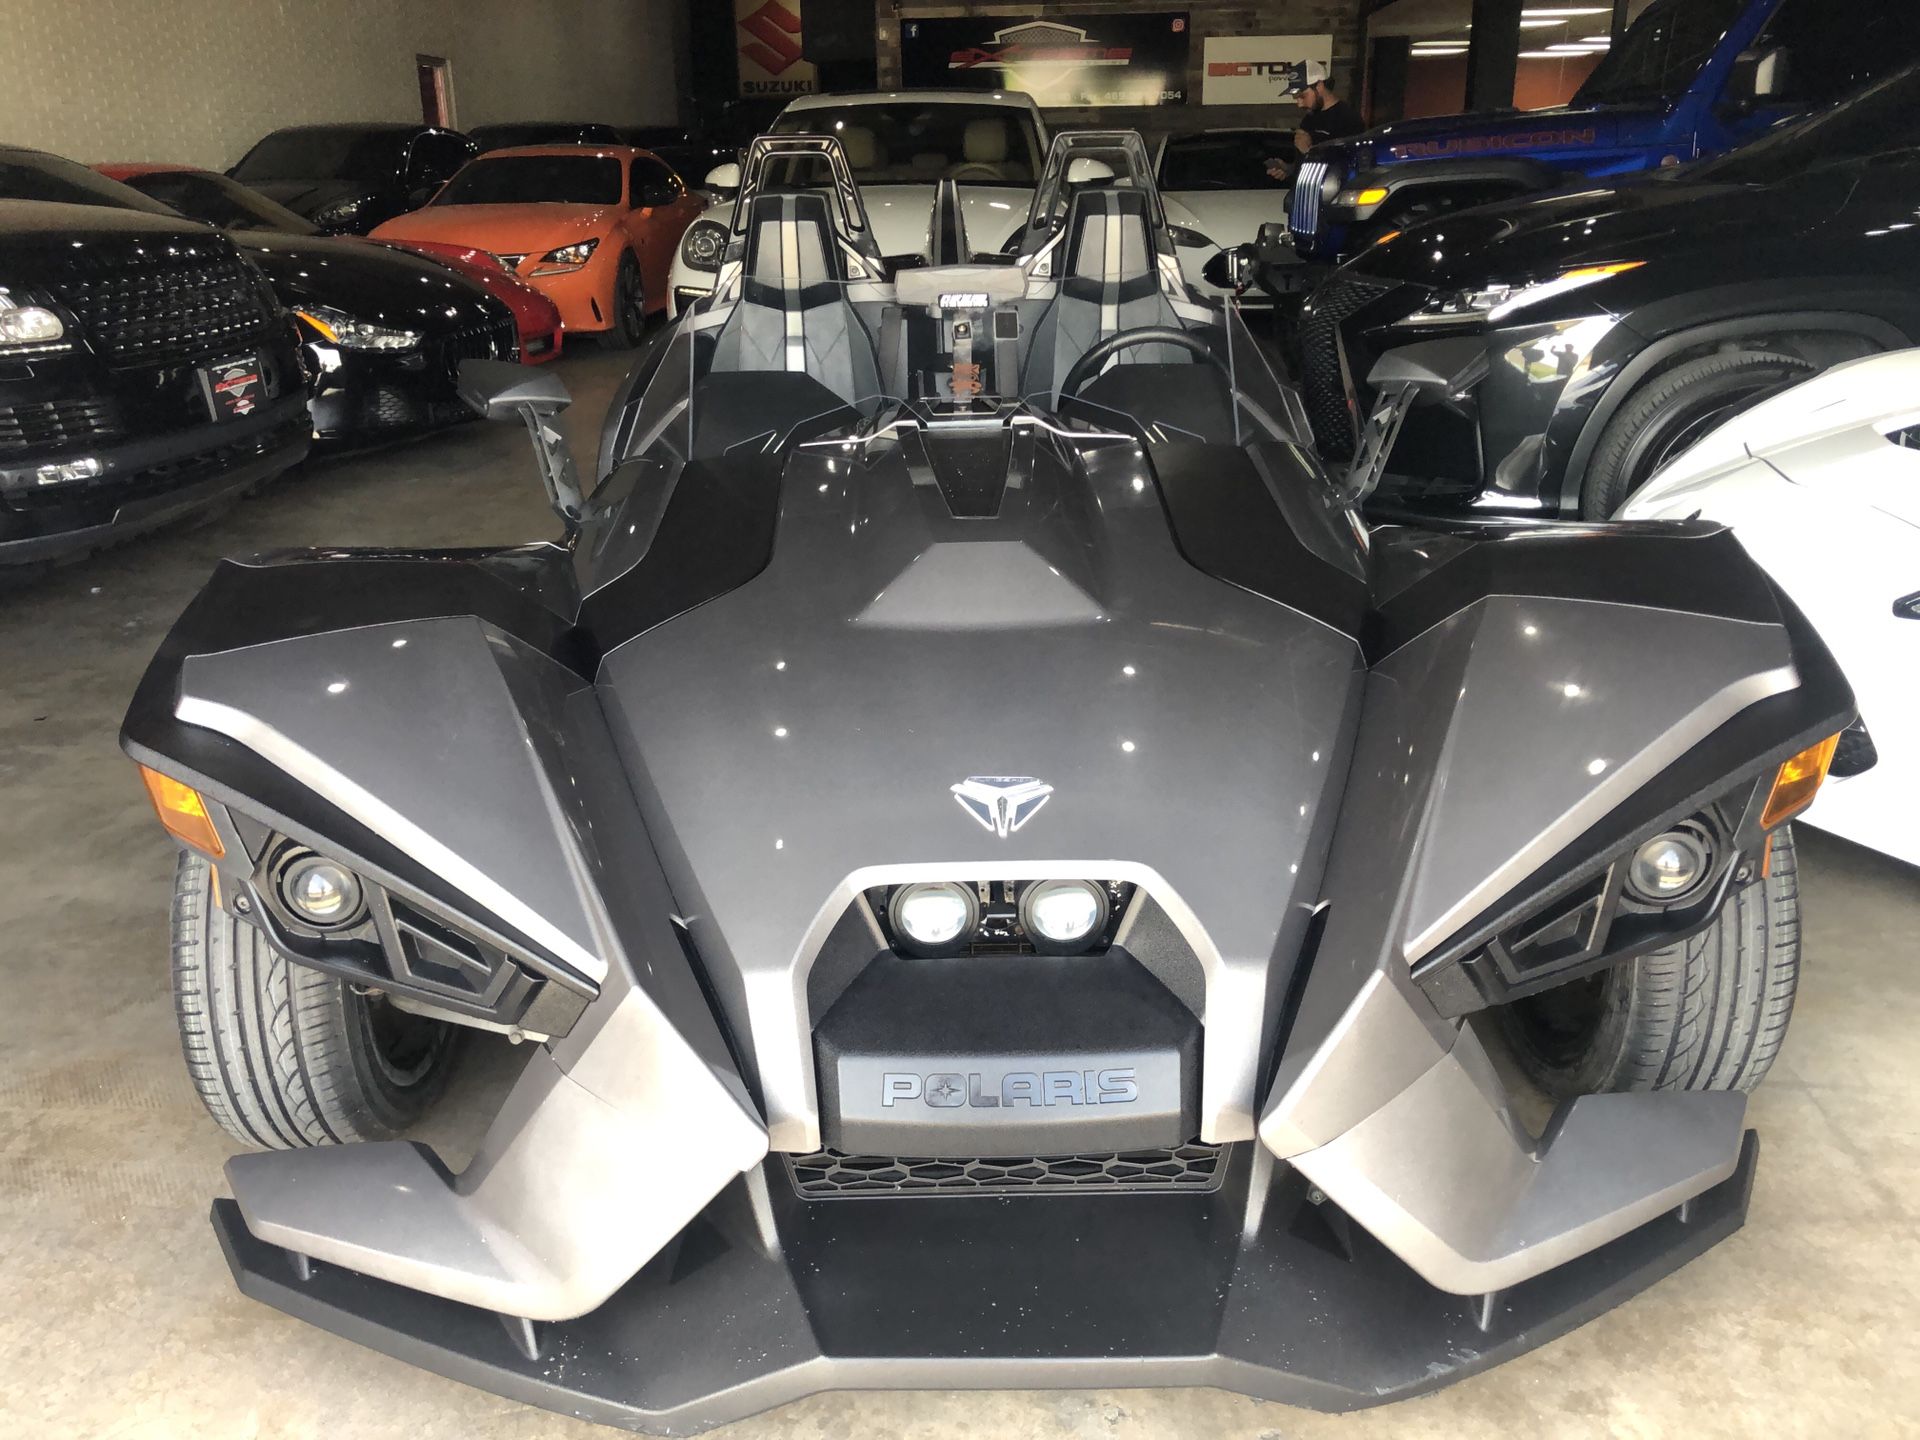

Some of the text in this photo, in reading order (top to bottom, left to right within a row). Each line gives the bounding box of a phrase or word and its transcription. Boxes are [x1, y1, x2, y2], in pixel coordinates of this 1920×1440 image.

[742, 80, 813, 94] SUZUKI
[1391, 128, 1596, 159] RUBICON
[881, 1067, 1139, 1108] POLARIS
